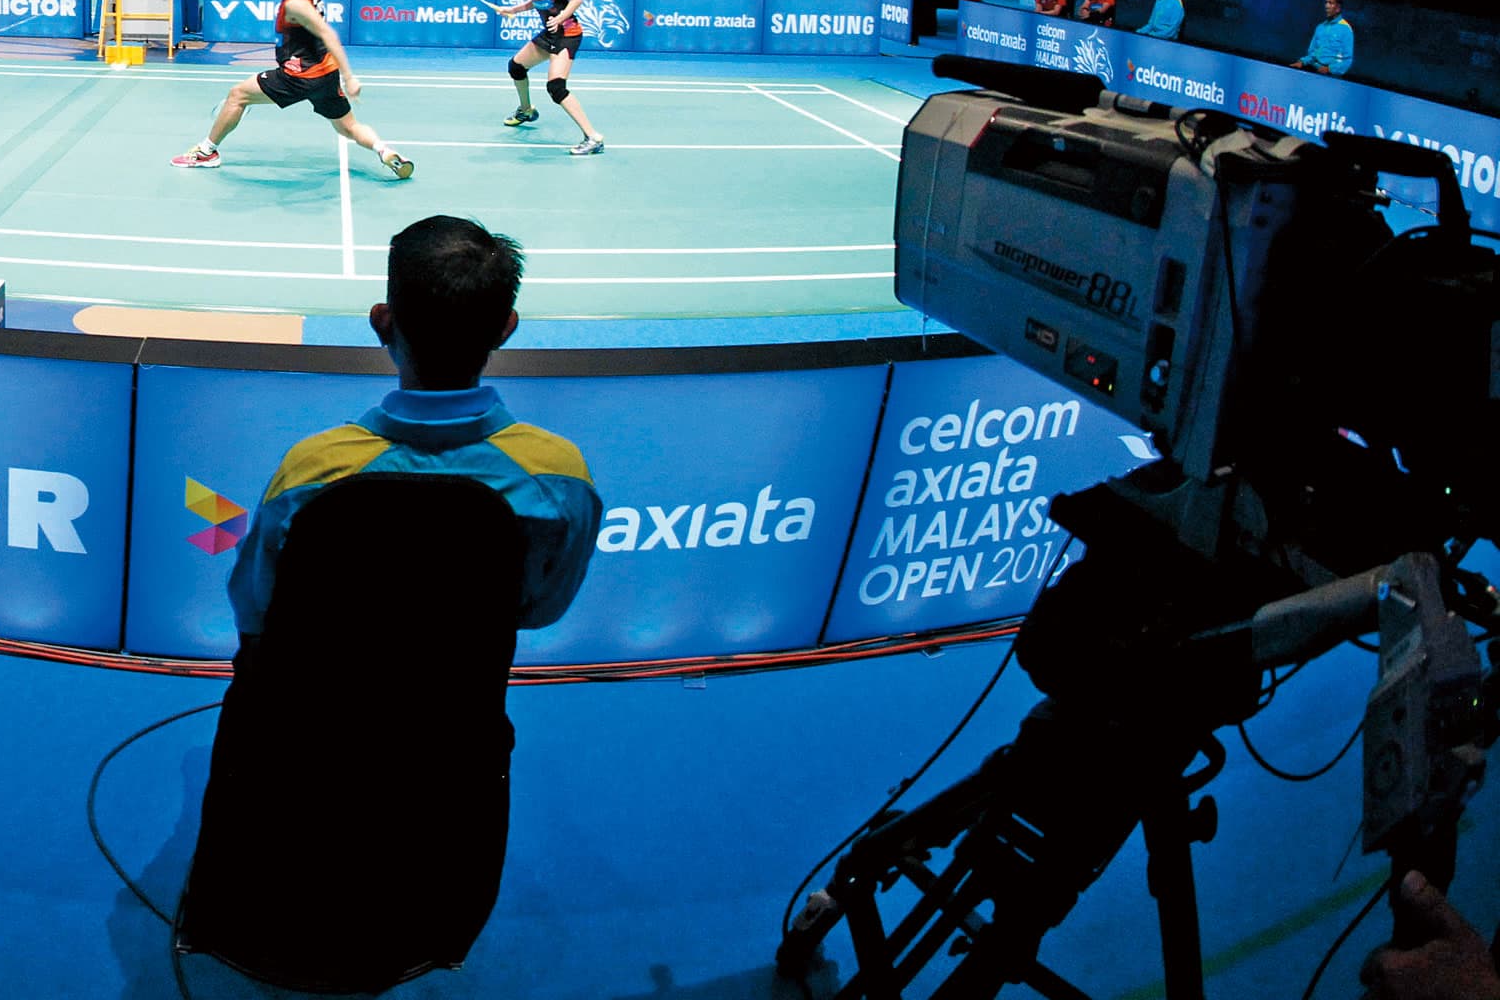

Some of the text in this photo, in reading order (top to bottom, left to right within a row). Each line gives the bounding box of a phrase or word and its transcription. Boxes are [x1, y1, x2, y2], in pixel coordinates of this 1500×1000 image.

[655, 11, 756, 29] celcom axiata
[770, 12, 875, 36] SAMSUNG
[881, 2, 909, 25] ICTOR
[500, 29, 532, 41] OPEN
[967, 22, 1027, 52] celcom axiata
[1036, 23, 1066, 41] celcom
[1036, 37, 1060, 53] axiata
[1035, 51, 1070, 71] MALAYSIA
[1135, 65, 1225, 105] celcom axiata
[900, 399, 1080, 456] celcom
[884, 446, 1038, 508] axiata
[596, 484, 816, 553] axiata
[869, 496, 1061, 559] MALAYS
[859, 552, 984, 606] OPEN
